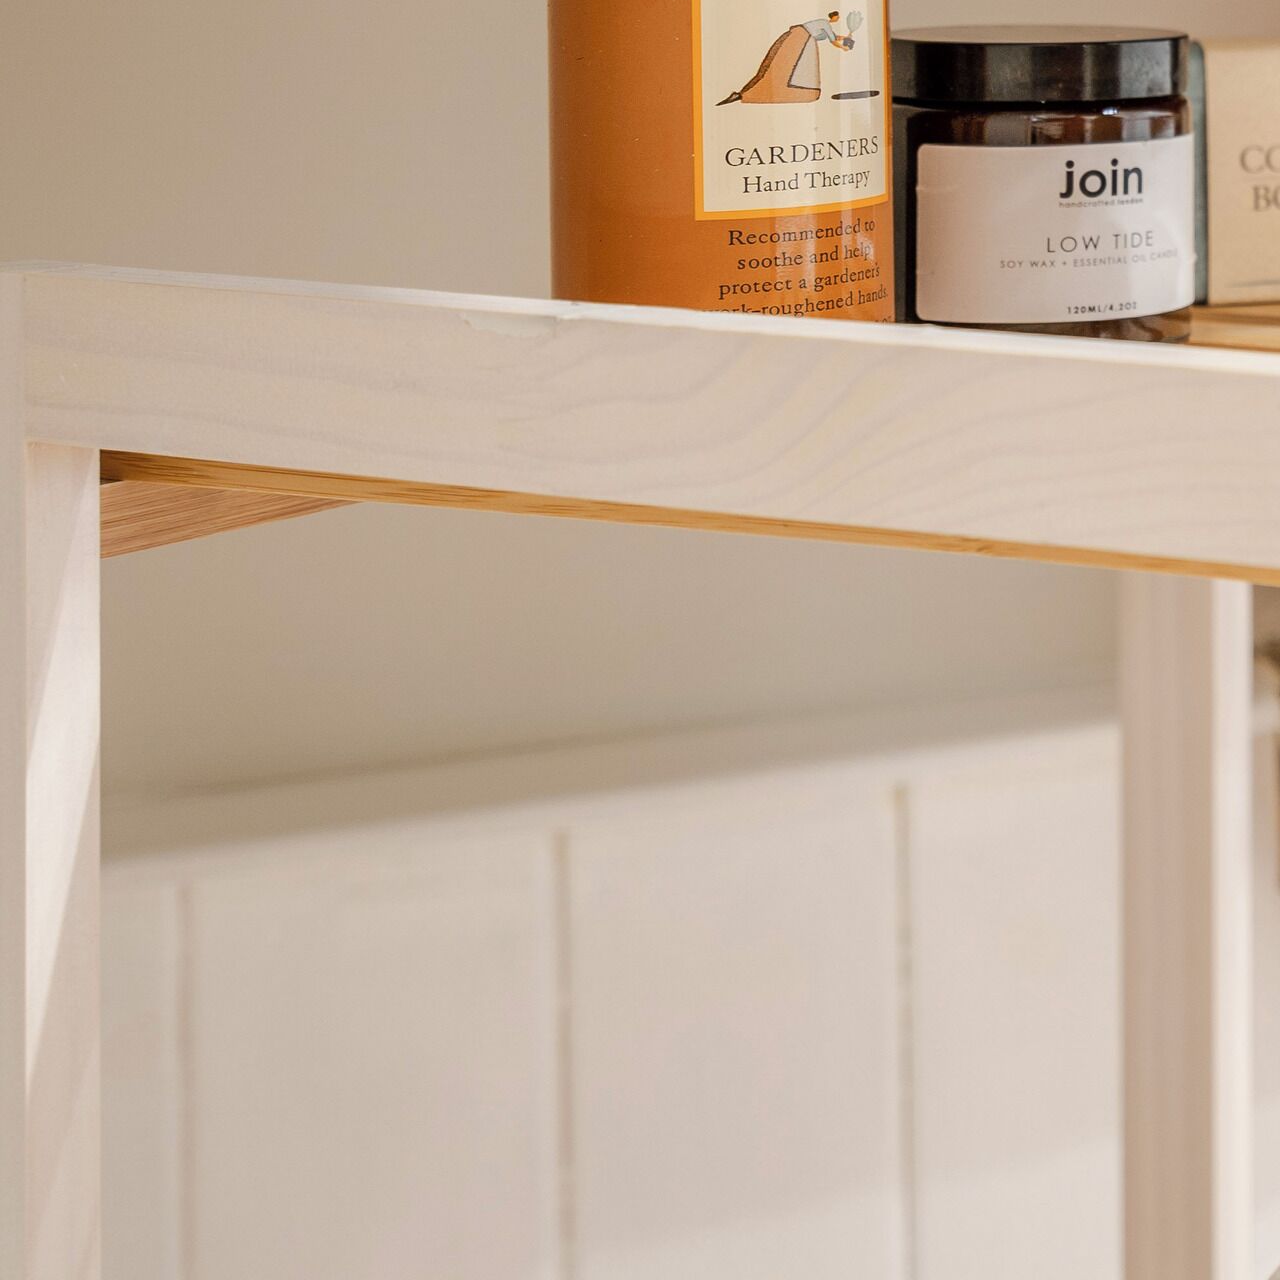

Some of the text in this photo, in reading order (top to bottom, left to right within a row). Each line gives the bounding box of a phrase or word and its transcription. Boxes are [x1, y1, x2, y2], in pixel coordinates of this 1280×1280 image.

[725, 136, 879, 167] GARDENERS
[743, 170, 871, 194] Hand Therapy
[1059, 157, 1143, 199] join
[728, 218, 876, 246] Recommended to
[1047, 231, 1155, 254] LOW TIDE
[737, 241, 873, 270] soothe and help
[1000, 259, 1025, 269] SOY
[1030, 259, 1056, 269] WAX
[1073, 255, 1128, 268] ESSENTIAL
[719, 263, 881, 300] protect a gardener's
